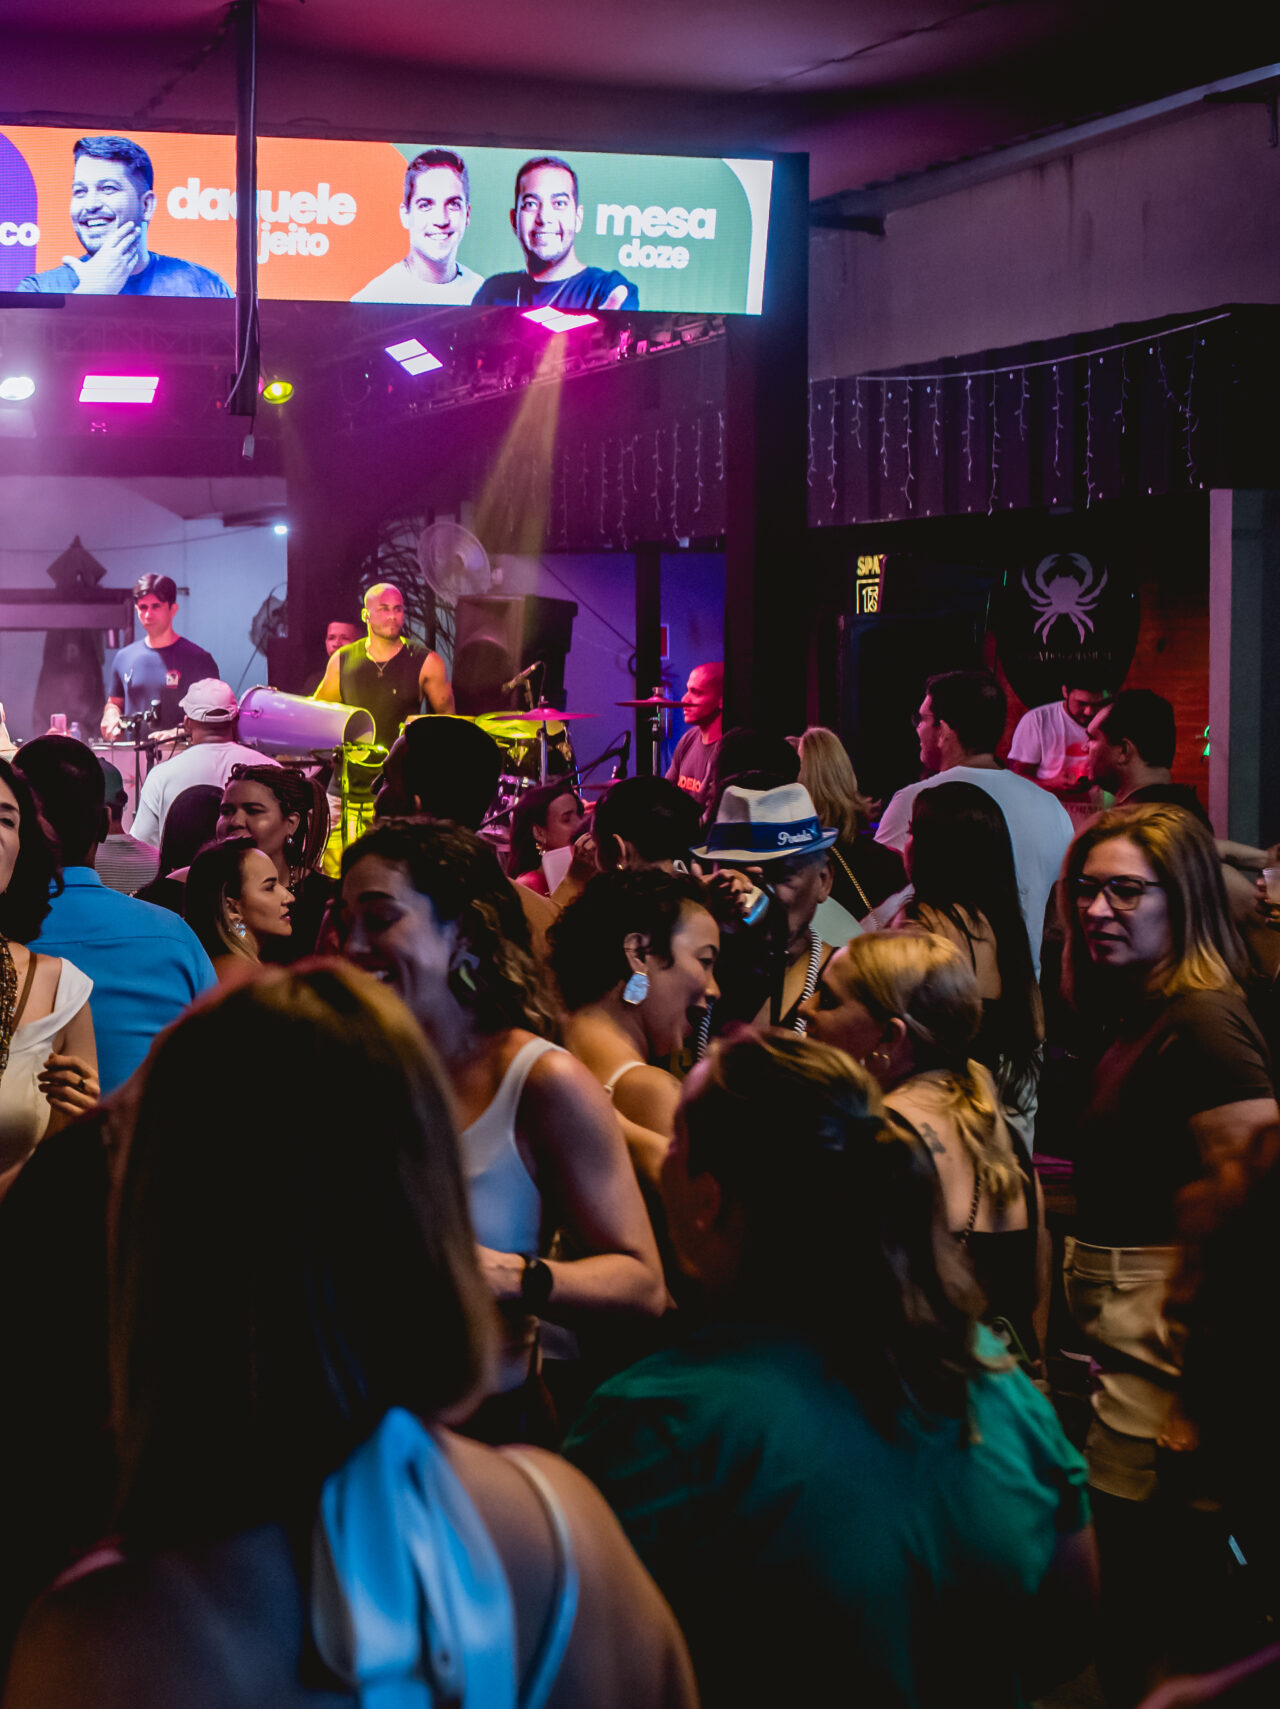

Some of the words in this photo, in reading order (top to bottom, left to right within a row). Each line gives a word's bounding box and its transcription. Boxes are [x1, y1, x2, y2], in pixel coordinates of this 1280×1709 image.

[167, 177, 357, 226] dauele
[596, 203, 717, 240] mesa
[257, 222, 330, 264] jeito
[618, 238, 690, 269] doze
[857, 554, 883, 576] SPA
